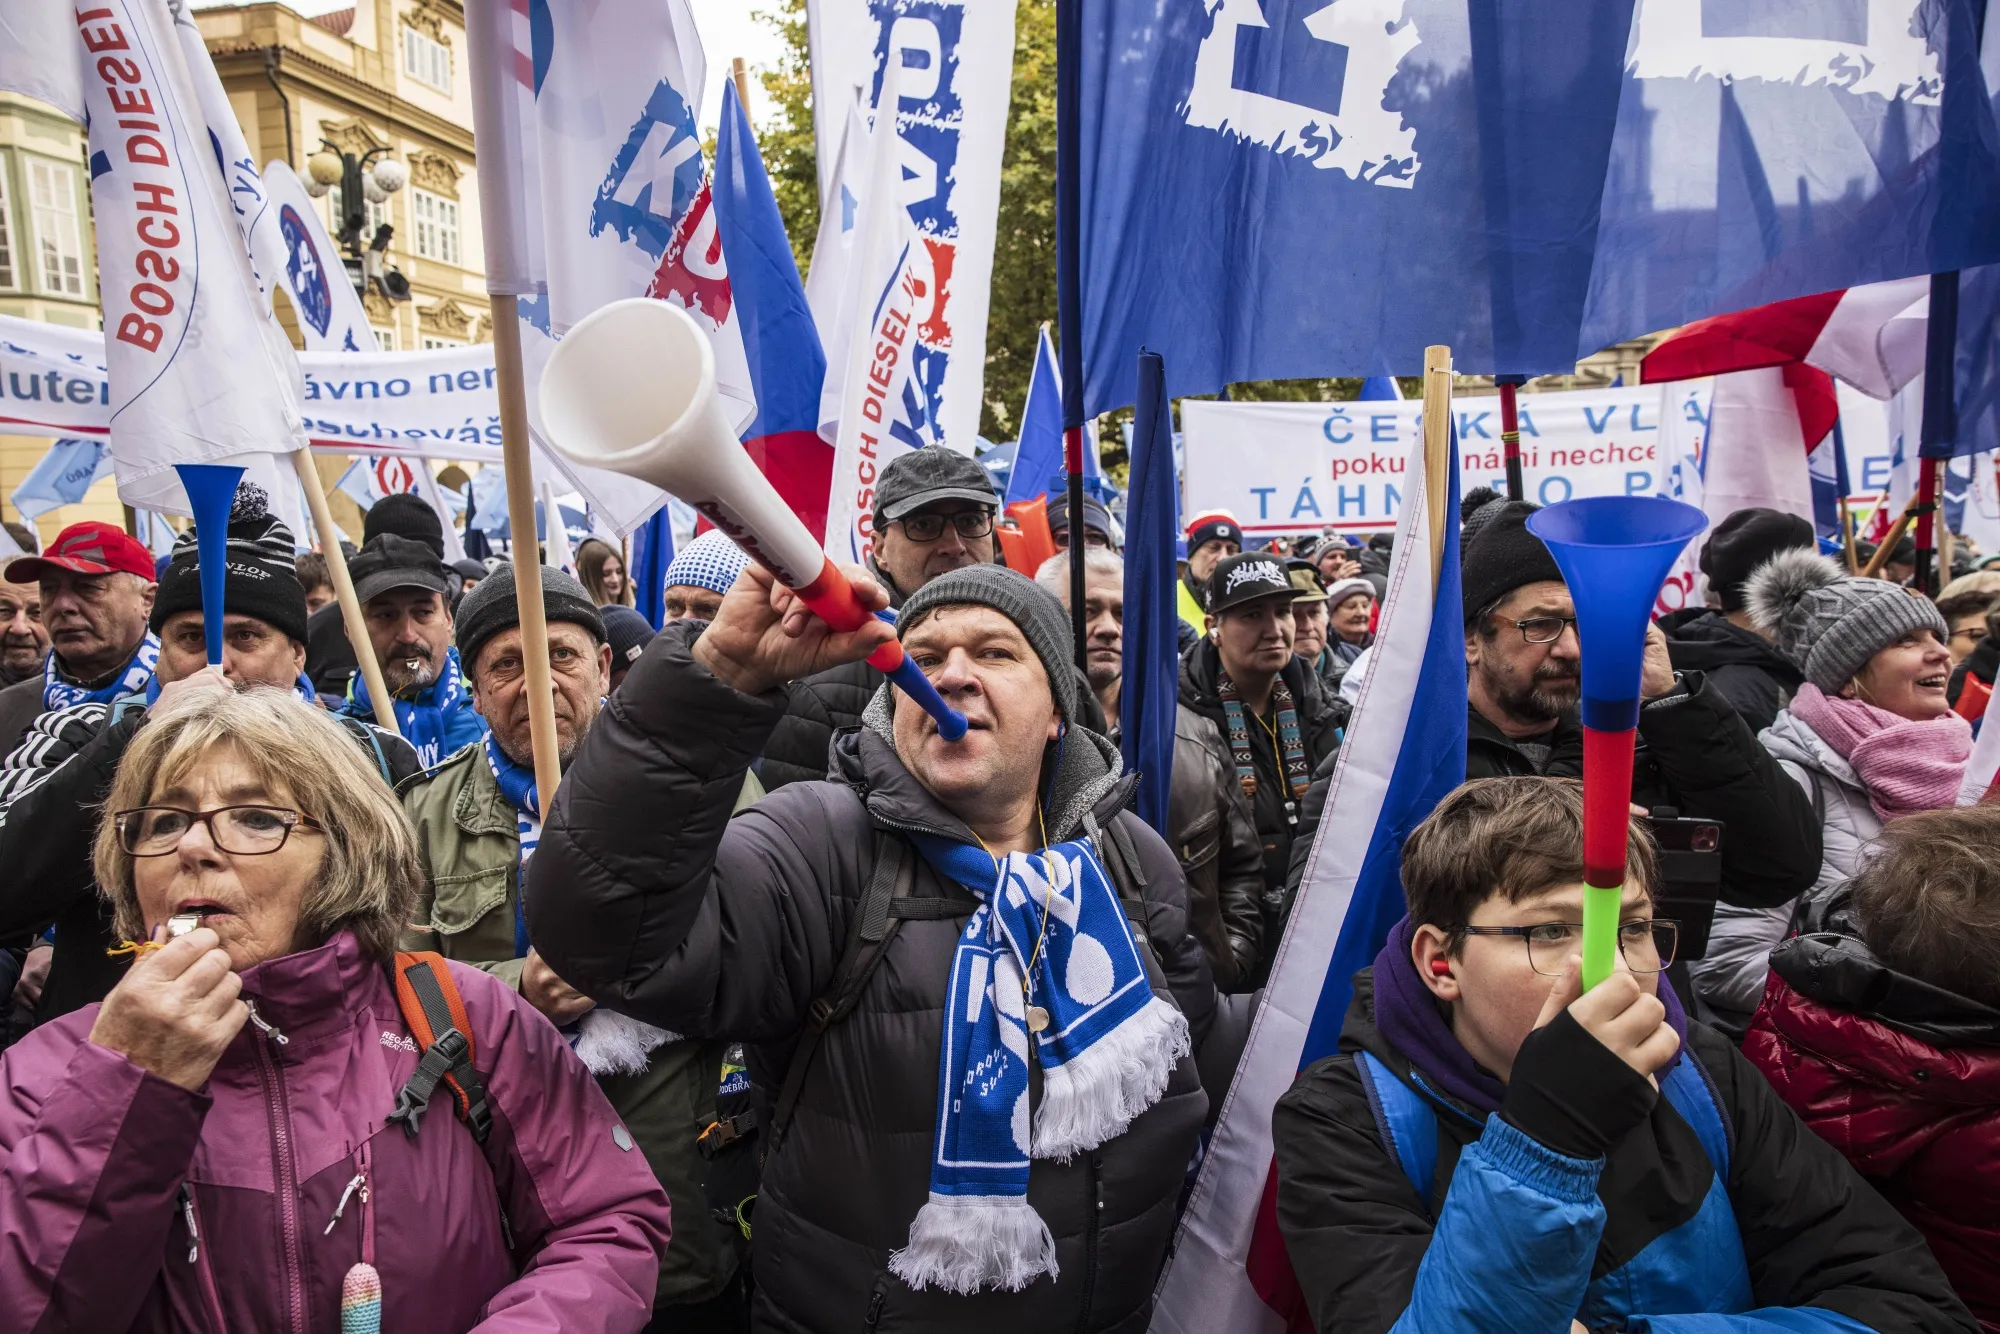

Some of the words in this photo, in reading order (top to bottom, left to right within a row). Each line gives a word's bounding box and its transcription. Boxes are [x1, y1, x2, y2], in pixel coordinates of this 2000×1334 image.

[862, 308, 911, 424] DIESEL
[191, 561, 272, 579] DNLOP
[231, 569, 266, 581] SPORT
[718, 1080, 752, 1095] ODĚBRA
